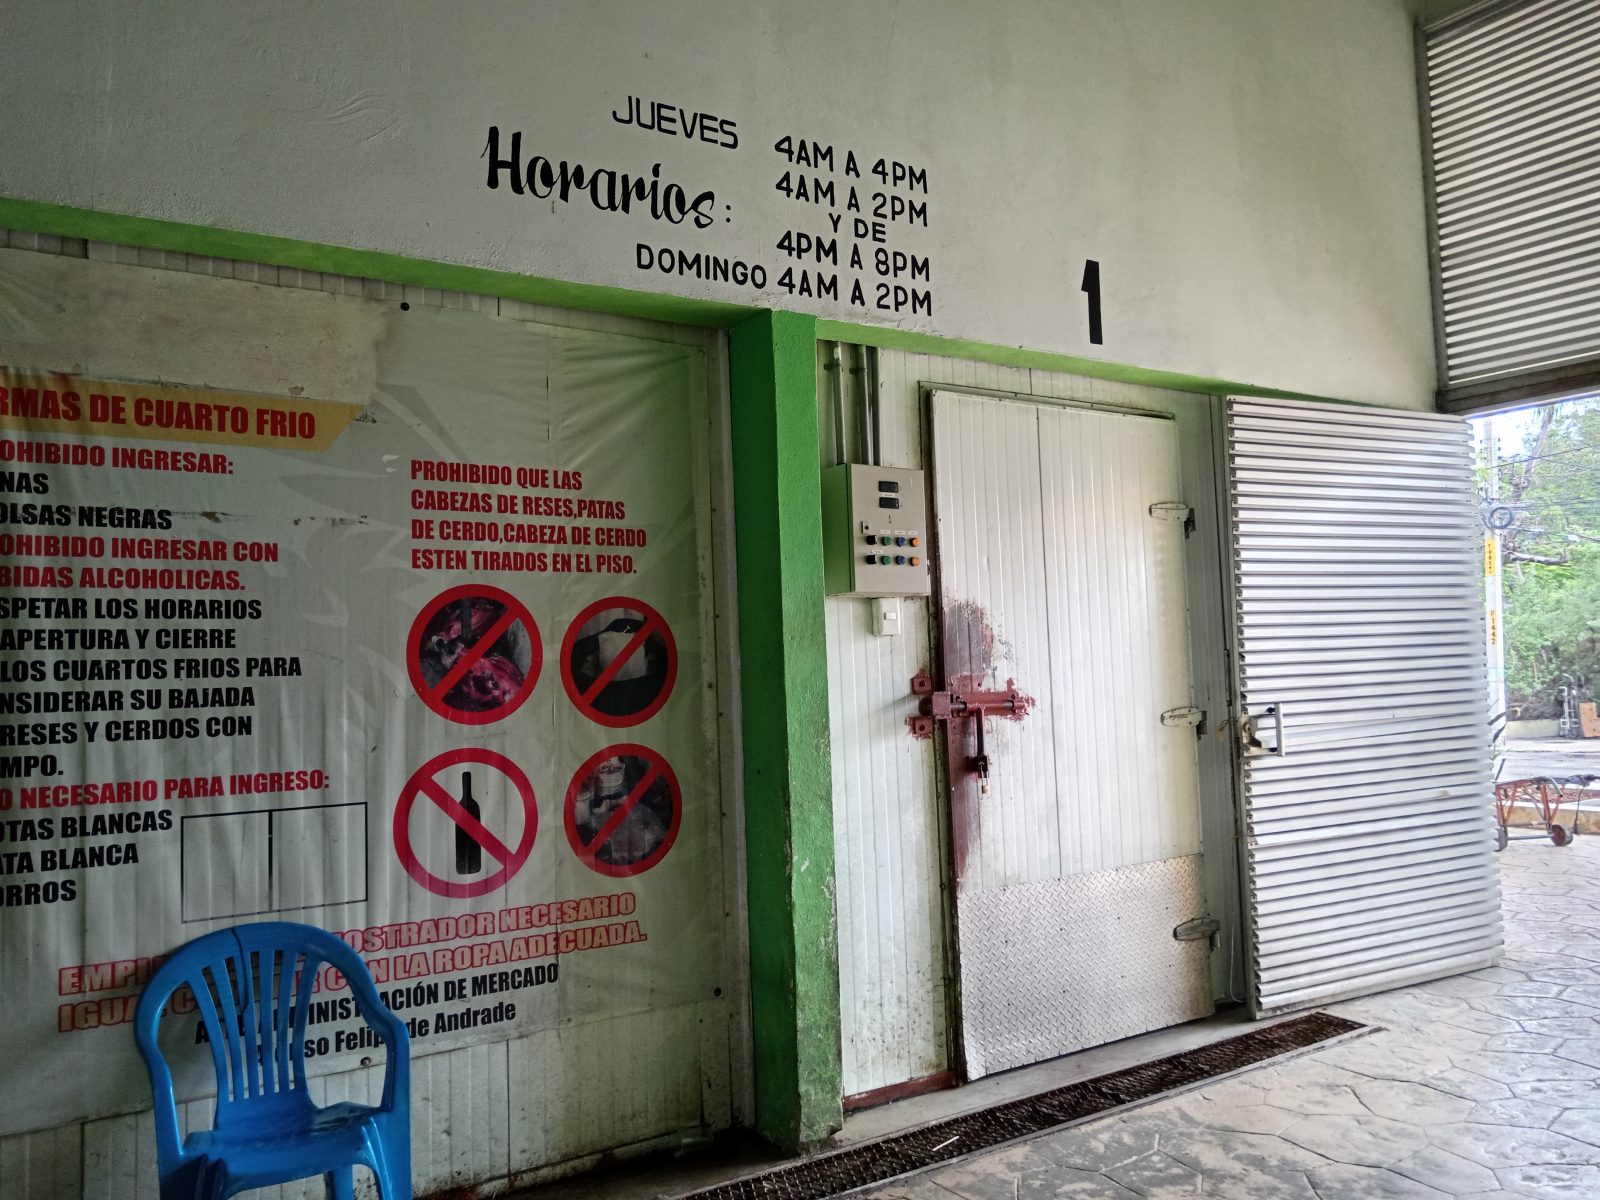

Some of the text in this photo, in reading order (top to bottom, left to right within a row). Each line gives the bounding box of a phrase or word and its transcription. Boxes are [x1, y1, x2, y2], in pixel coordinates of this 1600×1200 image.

[612, 95, 738, 150] JUEVES
[774, 135, 928, 194] 4AM A 4PM
[775, 171, 928, 227] 4AM A 2PM
[828, 212, 886, 243] Y DE
[777, 230, 930, 282] 4PM A 8PM
[636, 243, 932, 316] DOMINGO 4AM A 2PM
[1081, 259, 1103, 345] 1
[89, 393, 126, 425] DE
[134, 397, 249, 435] CUARTO
[256, 408, 316, 439] FRIO
[112, 447, 234, 474] INGRESAR:
[410, 459, 582, 491] PROHIBIDO QUE LAS
[78, 505, 172, 530] NEGRAS
[411, 489, 492, 513] CABEZAS
[497, 494, 518, 515] DE
[411, 519, 434, 540] DE
[571, 526, 591, 545] DE
[595, 527, 647, 548] CERDO
[111, 537, 227, 562] INGRESAR
[233, 541, 278, 562] CON
[411, 548, 637, 574] ESTEN TIRADOS EN EL PISO.
[79, 567, 246, 590] ALCOHOLICAS.
[94, 597, 138, 619] LOS
[144, 598, 262, 620] HORARIOS
[0, 628, 236, 650] APERTURA Y CIERRE
[0, 656, 302, 683] LOS CUARTOS FRIOS PARA
[130, 688, 161, 711] SU
[168, 686, 255, 709] BAJADA
[0, 715, 252, 747] RESES Y CERDOS CON
[20, 779, 158, 810] NECESARIO
[164, 776, 224, 800] PARA
[229, 769, 330, 795] INGRESO:
[61, 809, 173, 839] BLANCAS
[40, 843, 139, 872] BLANCA
[332, 892, 636, 954] OSTRADOR NECESARIO
[325, 920, 648, 991] CN LA ROPA ADECUADA.
[444, 978, 467, 1001] DE
[471, 963, 558, 997] MERCADO
[433, 1002, 516, 1034] Andrade
